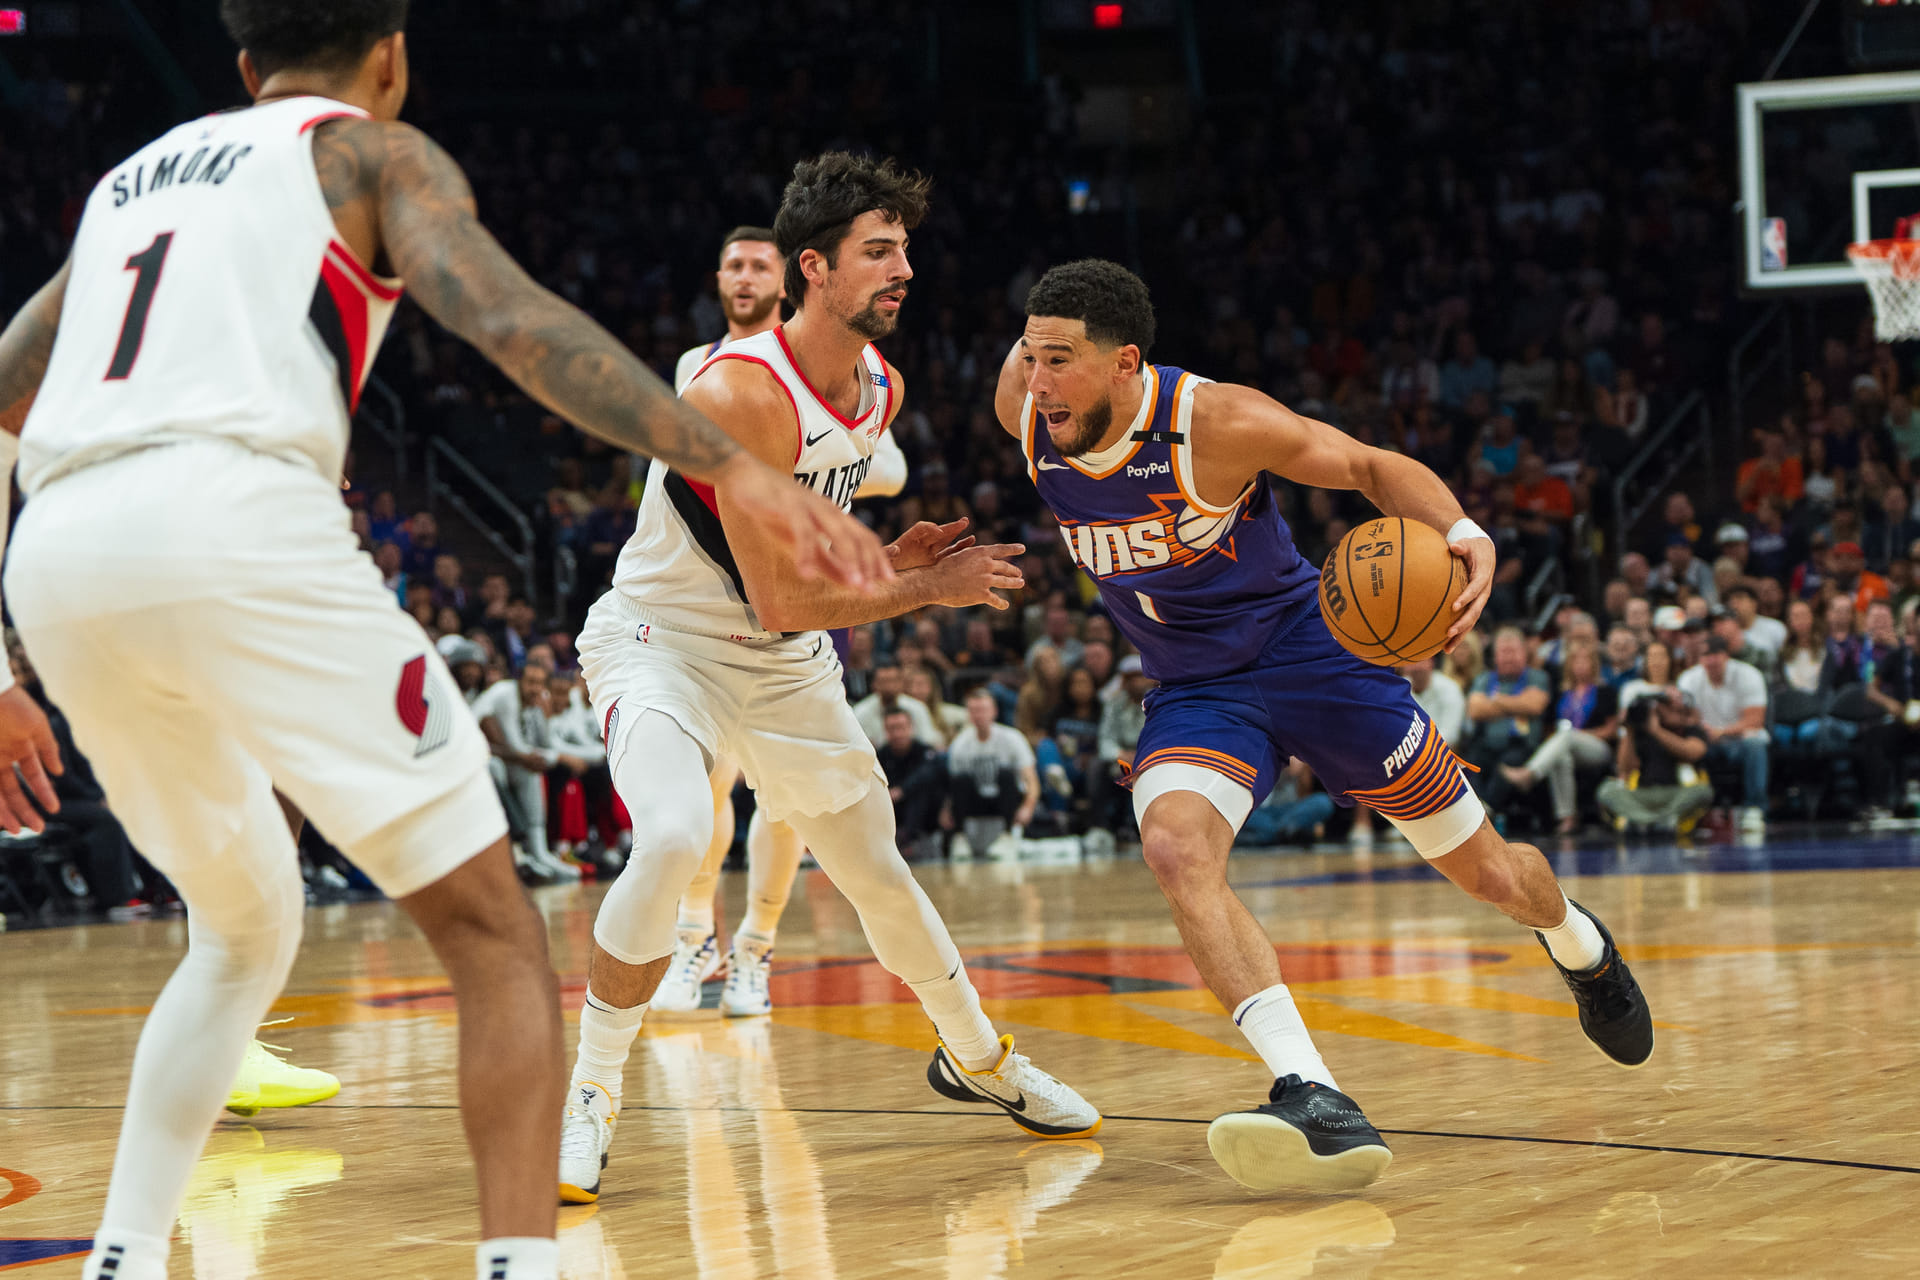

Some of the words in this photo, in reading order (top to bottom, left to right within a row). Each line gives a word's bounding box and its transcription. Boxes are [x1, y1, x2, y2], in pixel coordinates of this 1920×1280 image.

[112, 141, 253, 207] SIMONS
[102, 231, 175, 382] 1
[1126, 461, 1170, 479] PayPal
[1152, 432, 1161, 442] AL
[1382, 709, 1426, 779] PHOENIX
